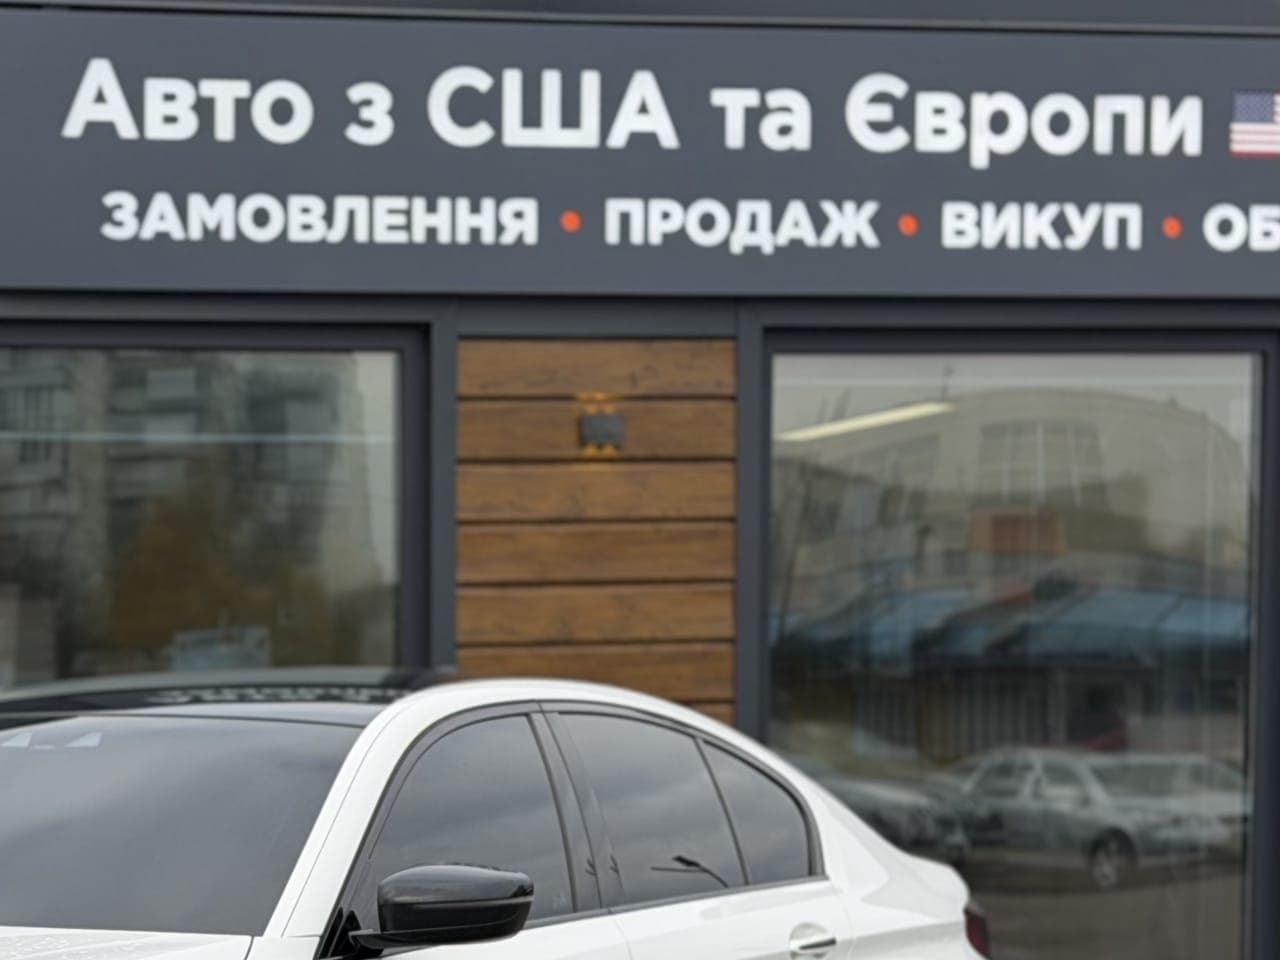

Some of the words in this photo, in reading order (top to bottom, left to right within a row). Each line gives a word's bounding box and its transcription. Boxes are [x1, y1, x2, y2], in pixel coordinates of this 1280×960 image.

[61, 57, 314, 145] Авто
[344, 81, 395, 146] з
[427, 65, 680, 149] США
[709, 87, 812, 151] та
[844, 72, 1203, 170] Європи
[100, 190, 539, 246] ЗАМОВЛЕННЯ
[604, 197, 880, 256] ПРОДАЖ
[941, 201, 1143, 251] ВИКУП
